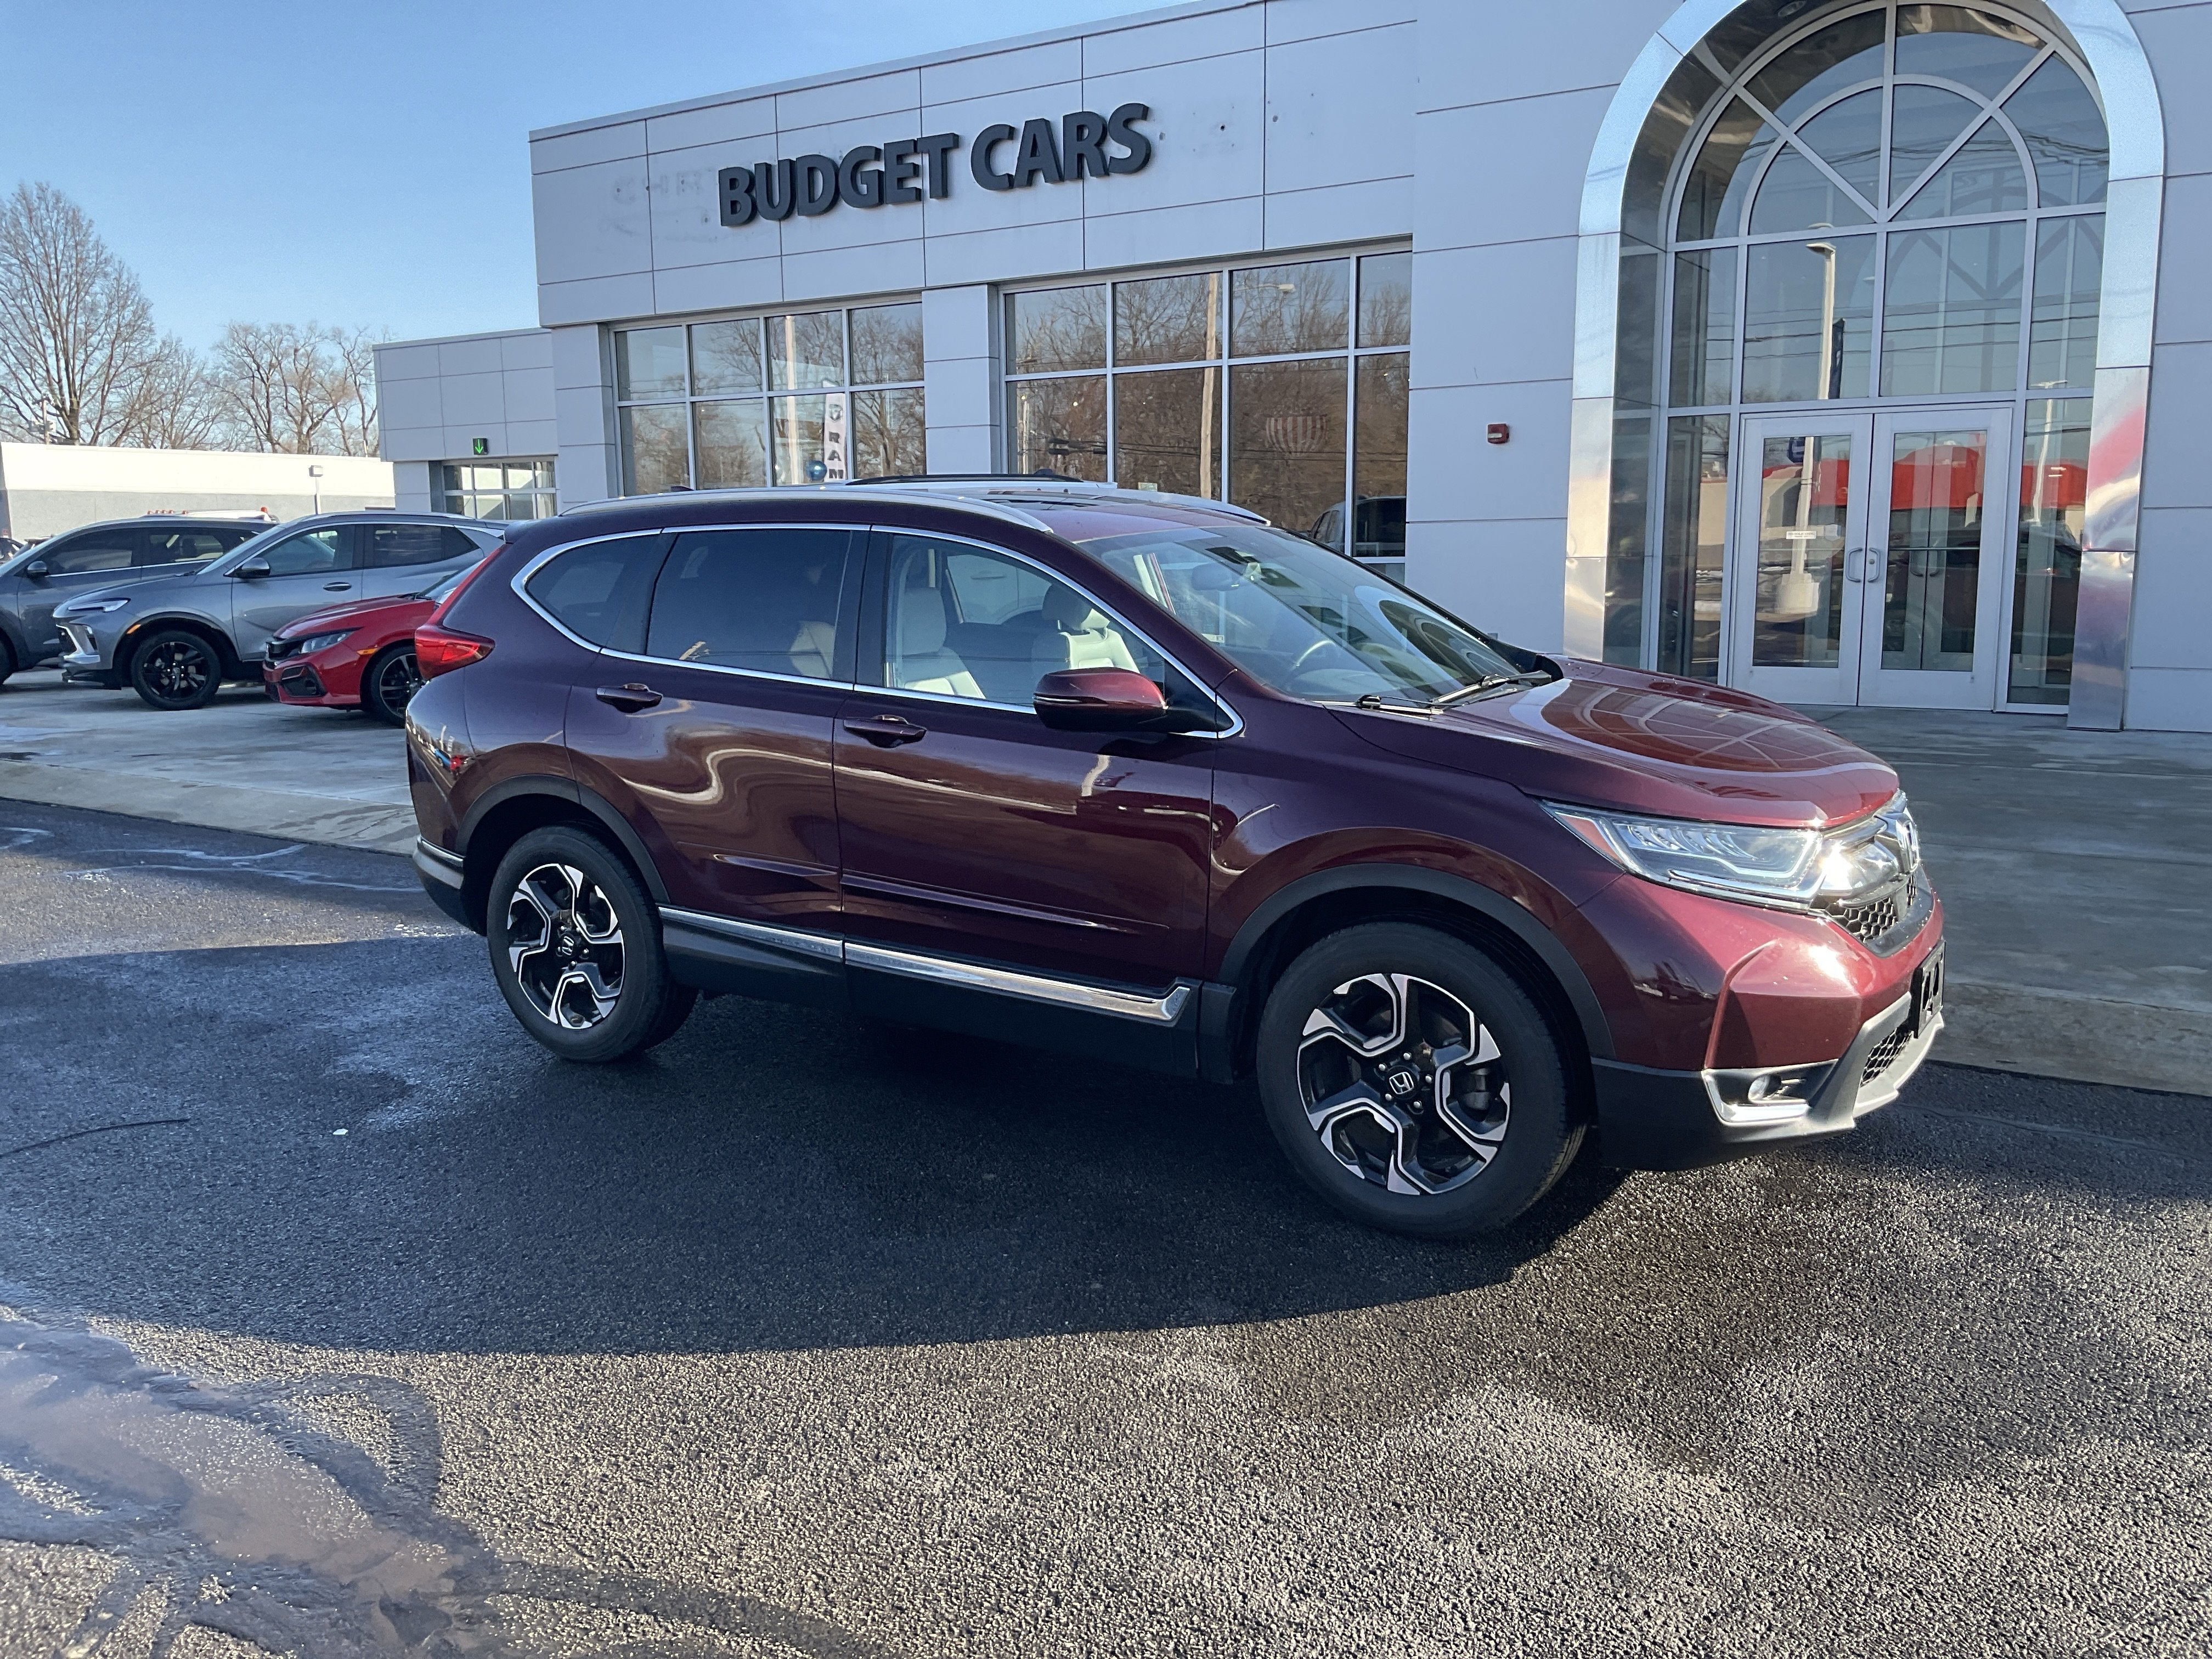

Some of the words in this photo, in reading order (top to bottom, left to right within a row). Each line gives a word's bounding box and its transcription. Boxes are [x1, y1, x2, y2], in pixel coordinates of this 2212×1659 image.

[718, 132, 960, 227] BUDGET
[970, 103, 1151, 191] CARS
[827, 431, 843, 479] RAM
